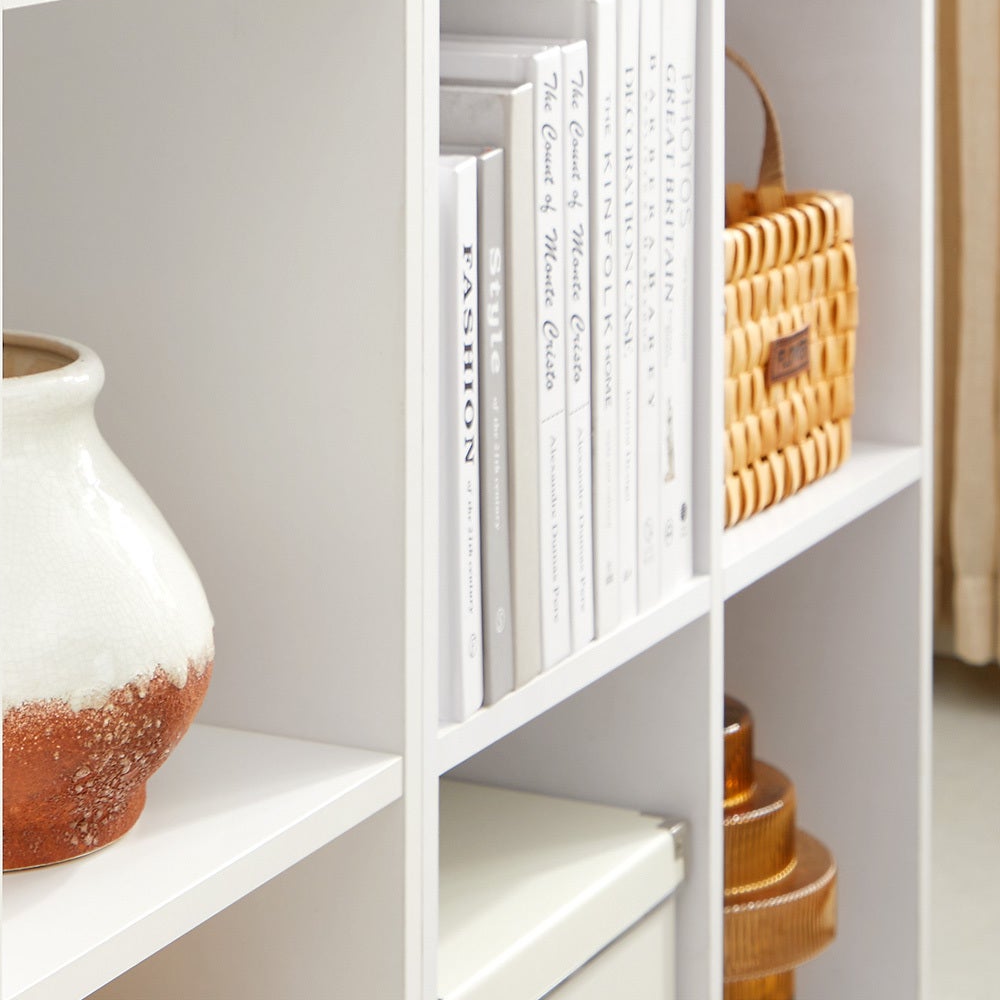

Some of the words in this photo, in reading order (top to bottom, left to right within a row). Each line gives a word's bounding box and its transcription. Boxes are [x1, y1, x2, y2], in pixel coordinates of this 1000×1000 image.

[543, 71, 558, 112] The
[570, 69, 585, 110] The
[665, 63, 676, 168] GREAT
[541, 123, 559, 187] Count
[569, 120, 585, 181] Count
[680, 73, 693, 229] PHOTOS
[540, 193, 557, 213] of
[567, 189, 583, 210] of
[543, 227, 559, 307] Monte
[571, 223, 585, 302] Monte
[603, 151, 613, 336] KINFOLK
[665, 177, 676, 302] BRITAIN
[462, 242, 475, 464] FASHION
[542, 319, 560, 391] Cristo
[569, 314, 586, 384] Cristo
